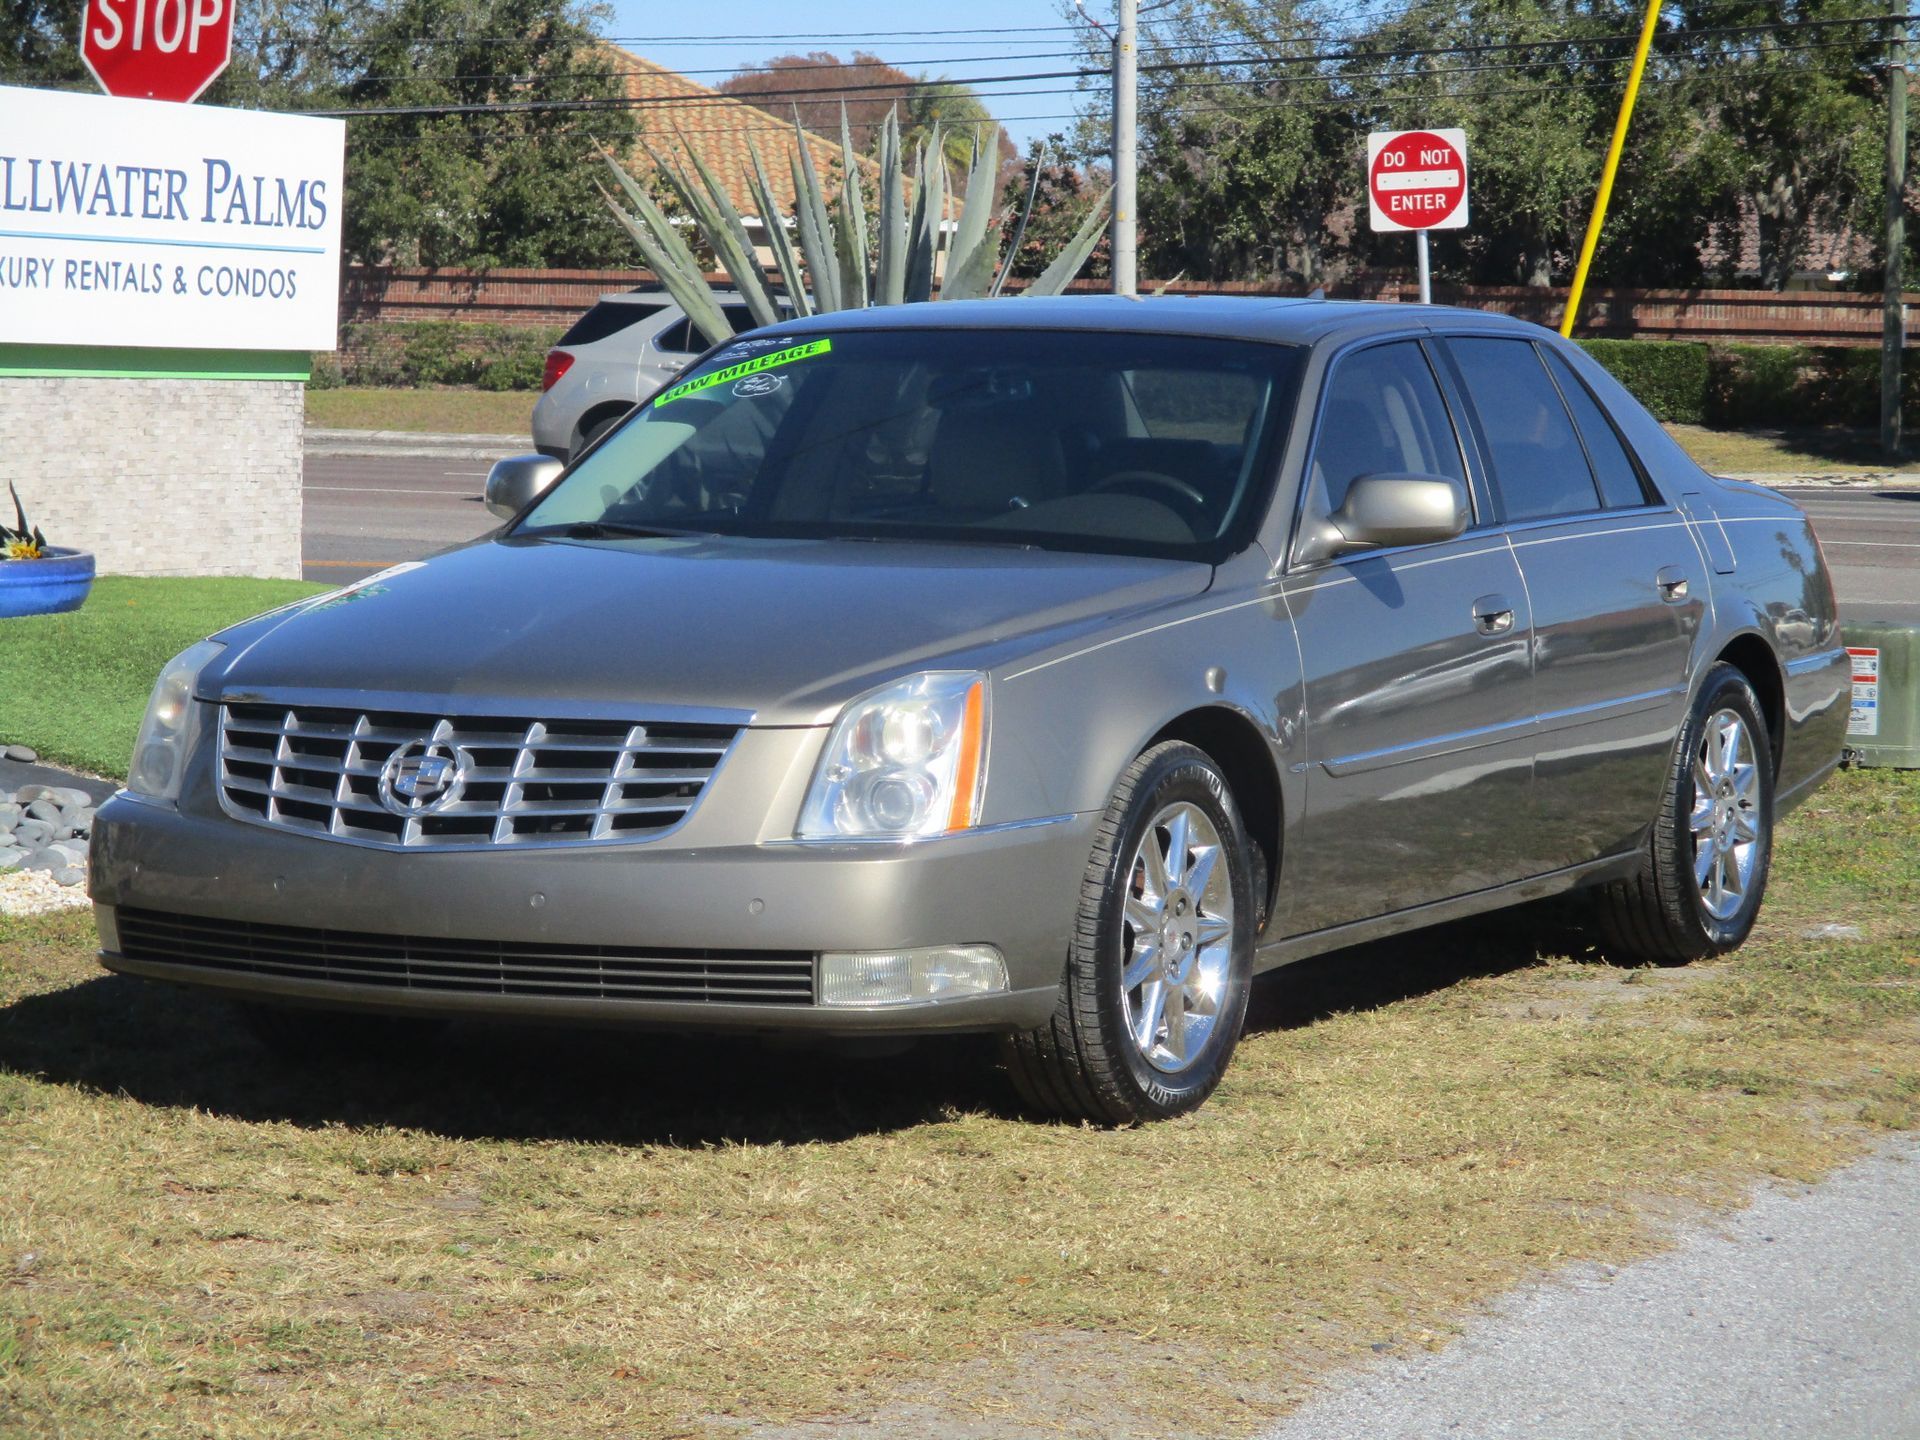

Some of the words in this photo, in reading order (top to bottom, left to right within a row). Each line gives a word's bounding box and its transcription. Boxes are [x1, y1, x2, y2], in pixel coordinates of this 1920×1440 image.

[93, 0, 223, 53] STOP
[1383, 151, 1406, 167] DO
[1420, 149, 1451, 165] NOT
[0, 156, 190, 221] LLWATER
[201, 157, 327, 231] PALMS
[1391, 193, 1446, 211] ENTER
[65, 259, 163, 295] RENTALS
[173, 265, 188, 294] &
[198, 265, 297, 299] CONDOS
[662, 376, 712, 401] LOW
[717, 343, 818, 382] MILEAGE
